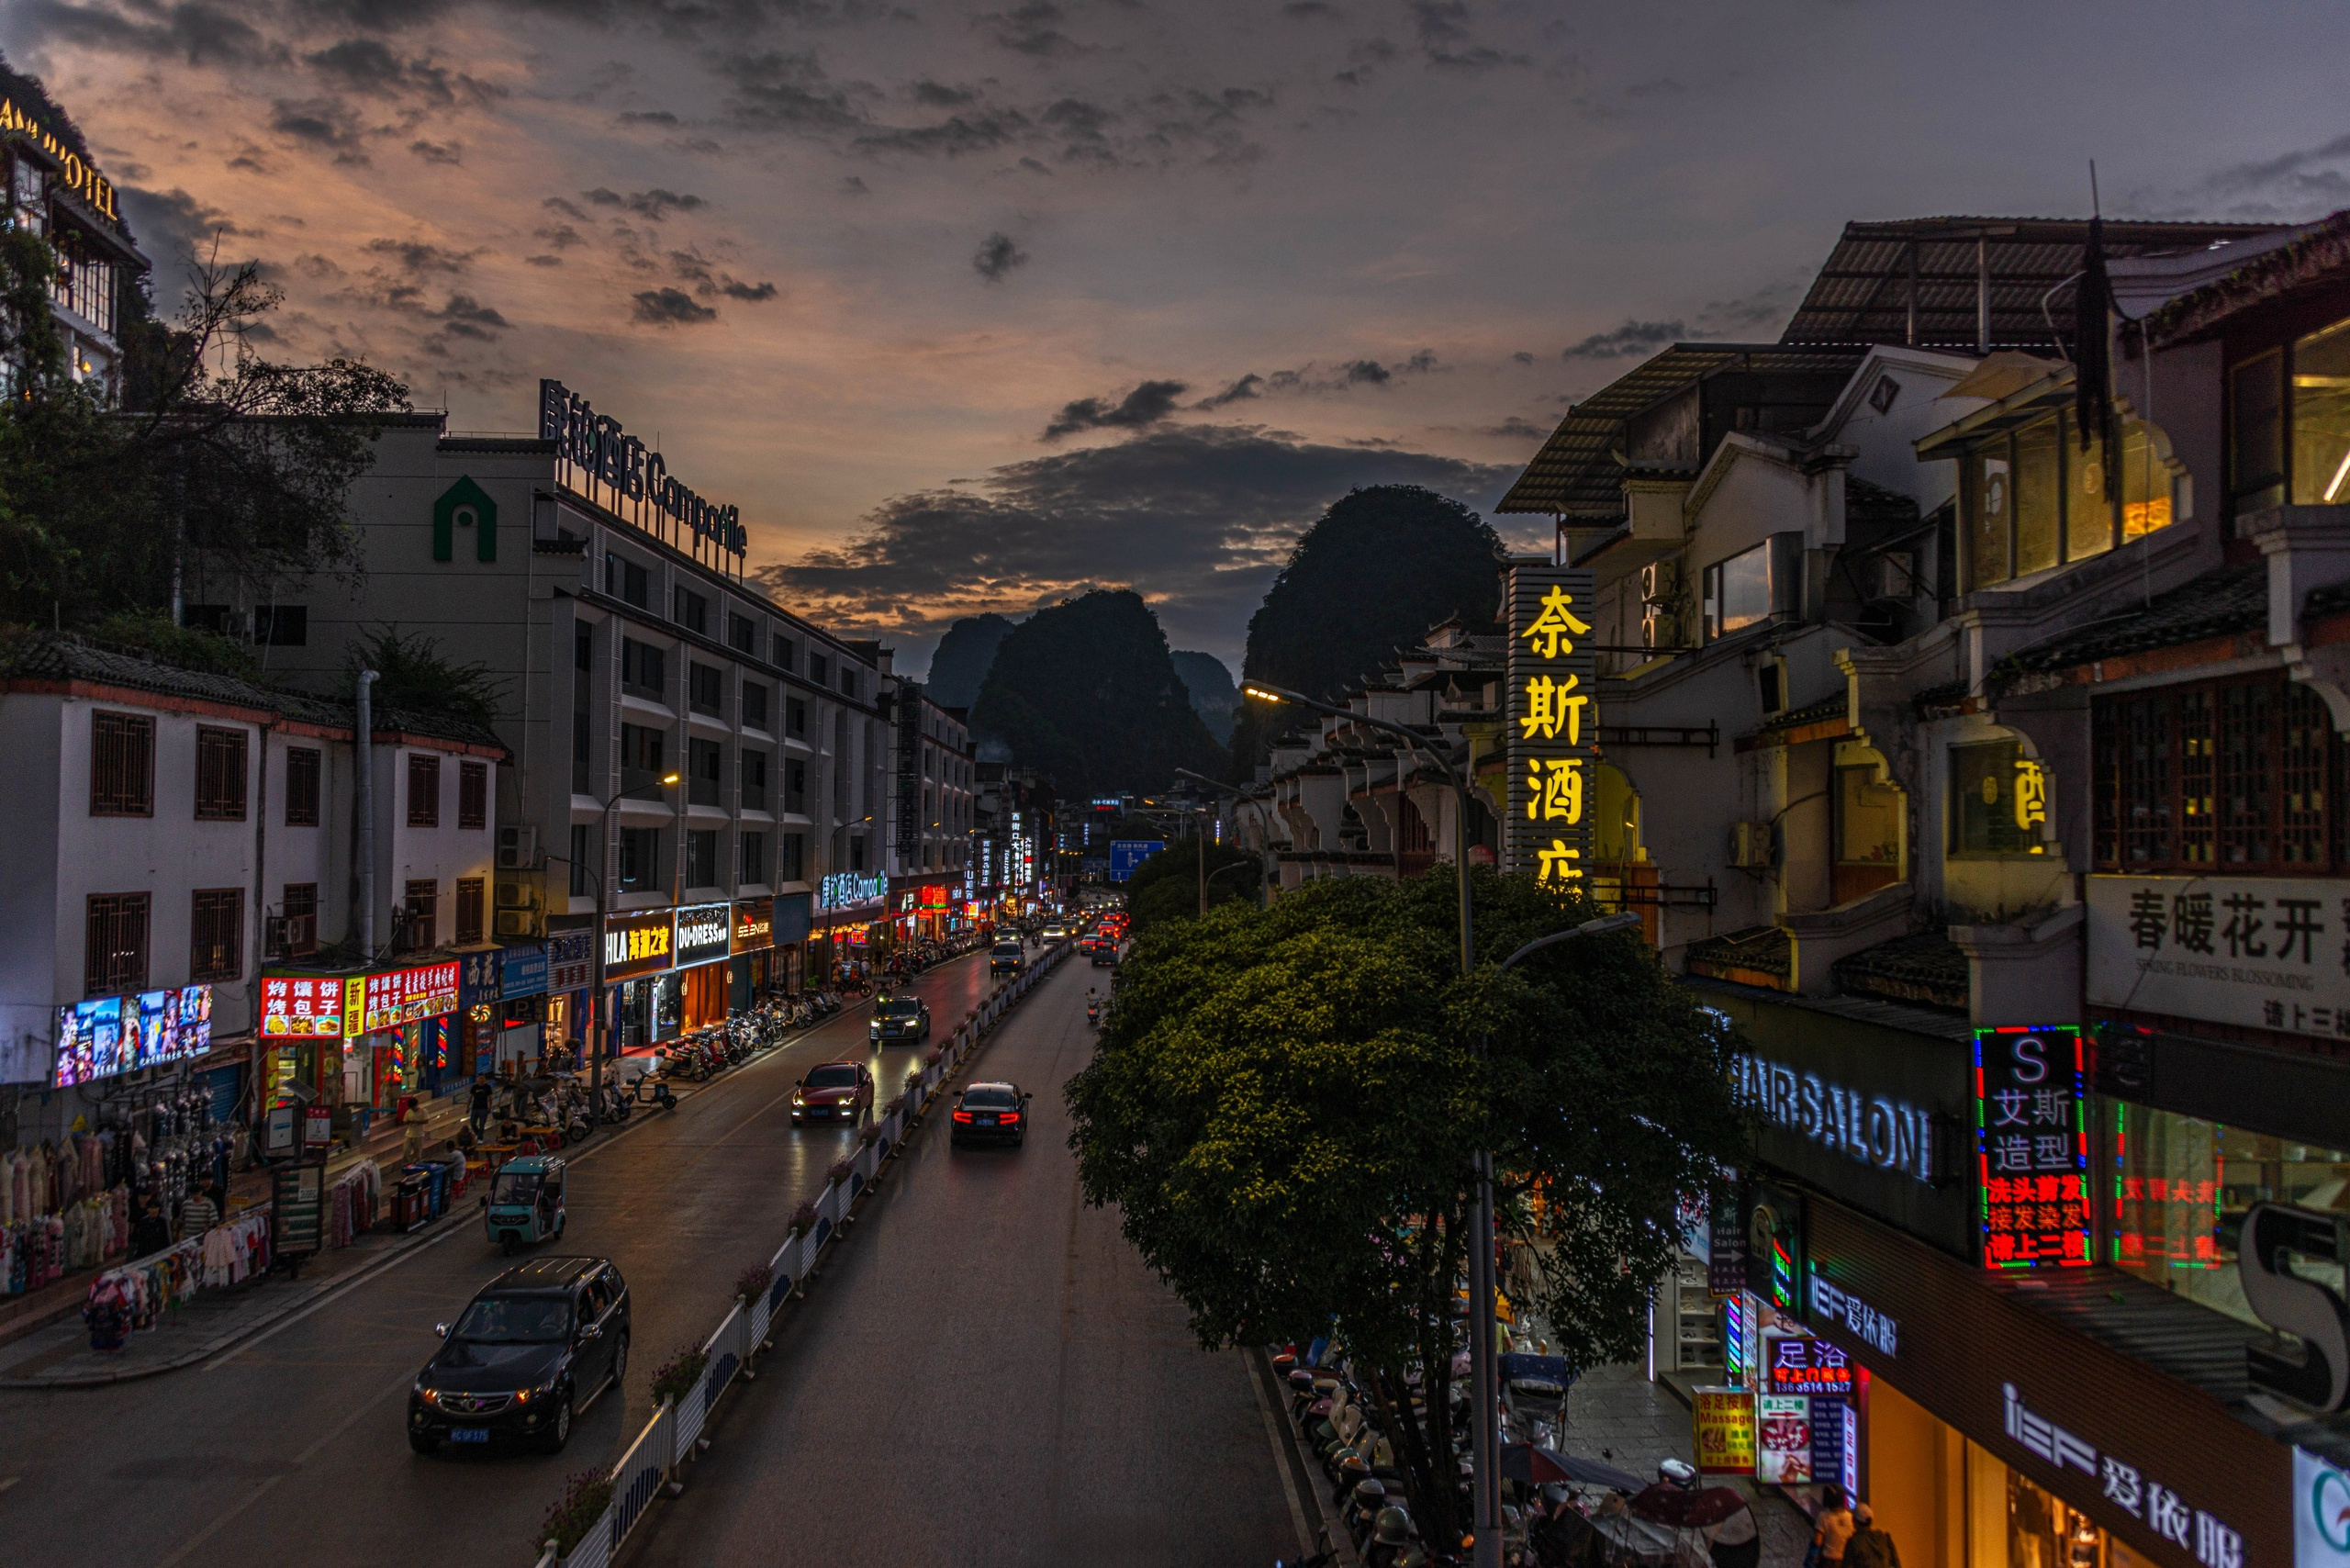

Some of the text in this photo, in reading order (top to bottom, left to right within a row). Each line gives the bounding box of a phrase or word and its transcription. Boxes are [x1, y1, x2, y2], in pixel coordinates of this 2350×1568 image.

[646, 452, 747, 559] Campanile
[853, 869, 888, 905] Campanile
[2130, 889, 2324, 963] 春暖花开
[606, 930, 628, 965] HLA
[629, 926, 669, 960] 海澜之家
[267, 980, 339, 998] 烤馕饼
[369, 974, 401, 993] 烤馕饼
[267, 999, 339, 1015] 烤包子
[349, 981, 361, 1035] 新疆
[368, 991, 401, 1012] 烤包子
[2011, 1036, 2049, 1083] S
[1992, 1089, 2070, 1127] 艾斯
[1993, 1134, 2073, 1171] 造型
[1987, 1174, 2083, 1204] 洗头剪发
[1717, 1227, 1741, 1236] Hair
[1988, 1204, 2084, 1231] 接发染发
[1714, 1238, 1747, 1247] Salon
[1988, 1231, 2085, 1261] 请上二楼
[1845, 1294, 1897, 1360] 爱依服
[1774, 1340, 1849, 1368] 足浴
[1773, 1367, 1852, 1383] 可上门服务
[1700, 1412, 1752, 1427] Massage
[1763, 1399, 1805, 1411] 请上二楼
[2102, 1455, 2244, 1568] 爱依服
